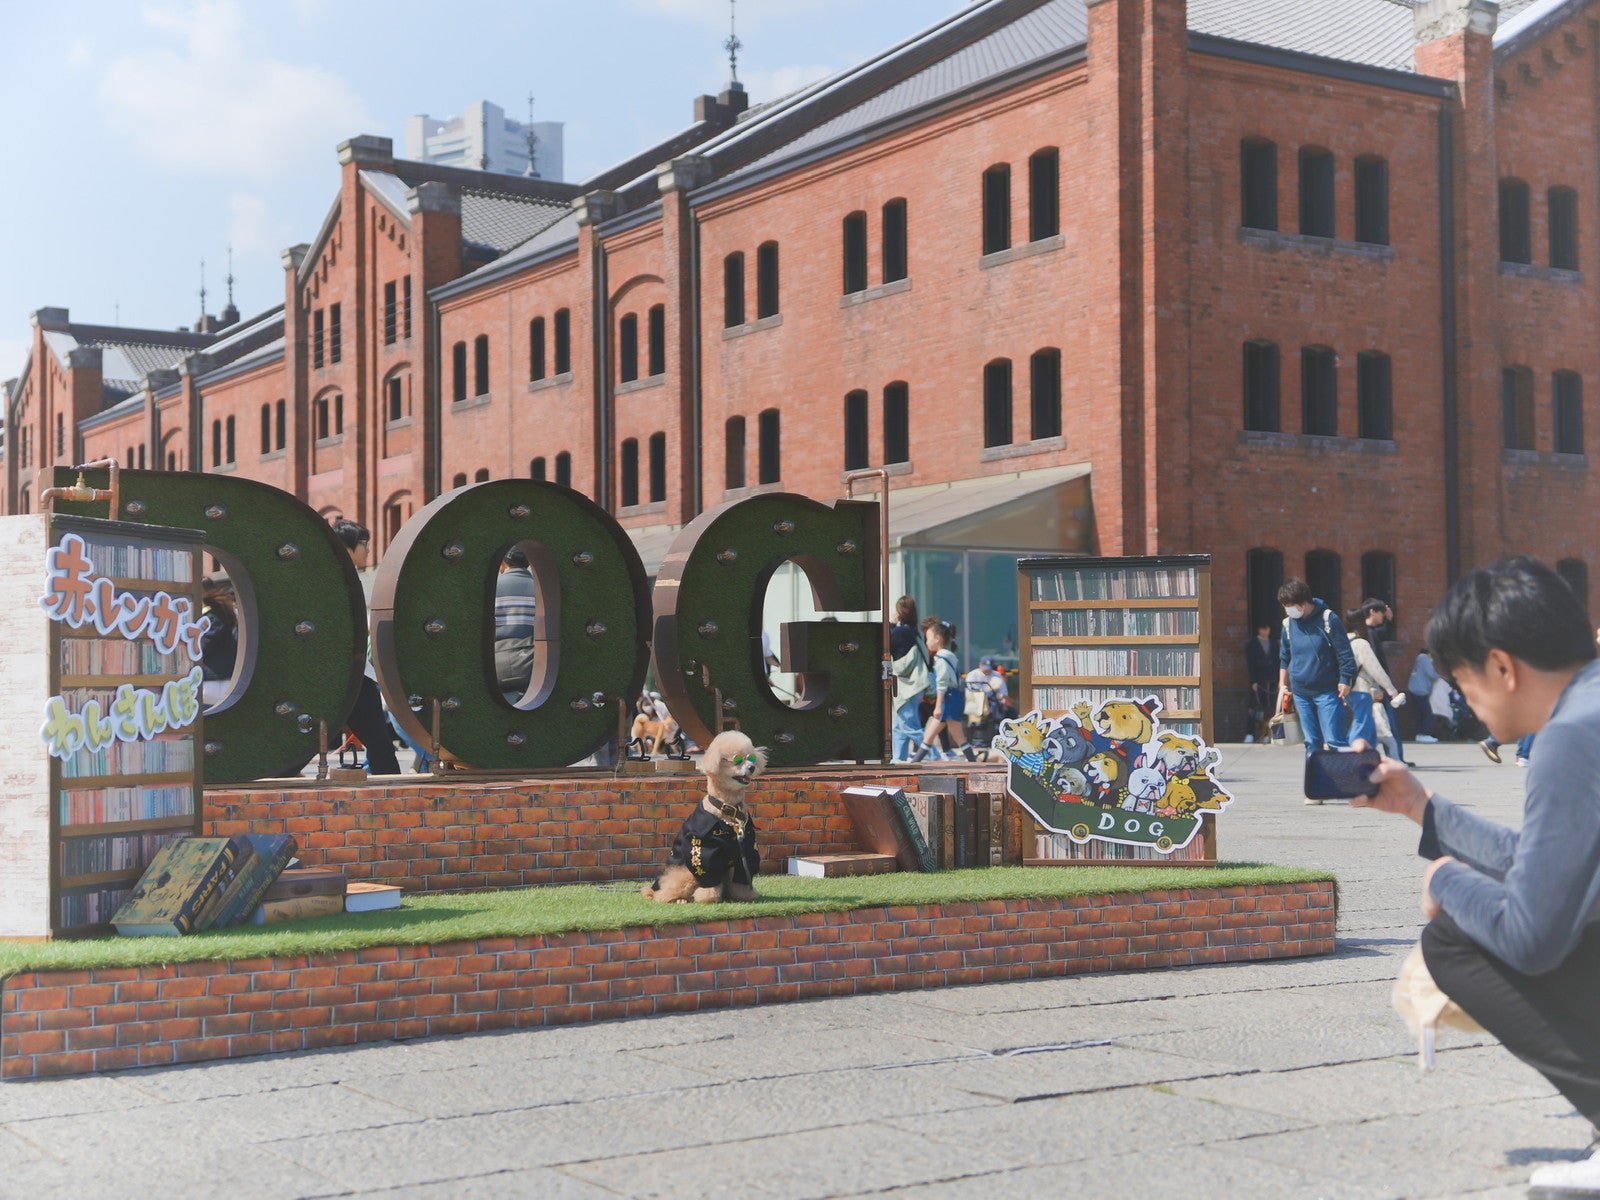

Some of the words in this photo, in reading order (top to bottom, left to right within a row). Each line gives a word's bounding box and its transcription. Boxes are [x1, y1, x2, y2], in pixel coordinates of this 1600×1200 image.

[42, 466, 892, 784] DOG
[44, 535, 210, 657] 赤レンガで
[44, 669, 204, 759] わんさんぽ
[1097, 812, 1165, 837] DOG
[191, 861, 228, 914] PARIS
